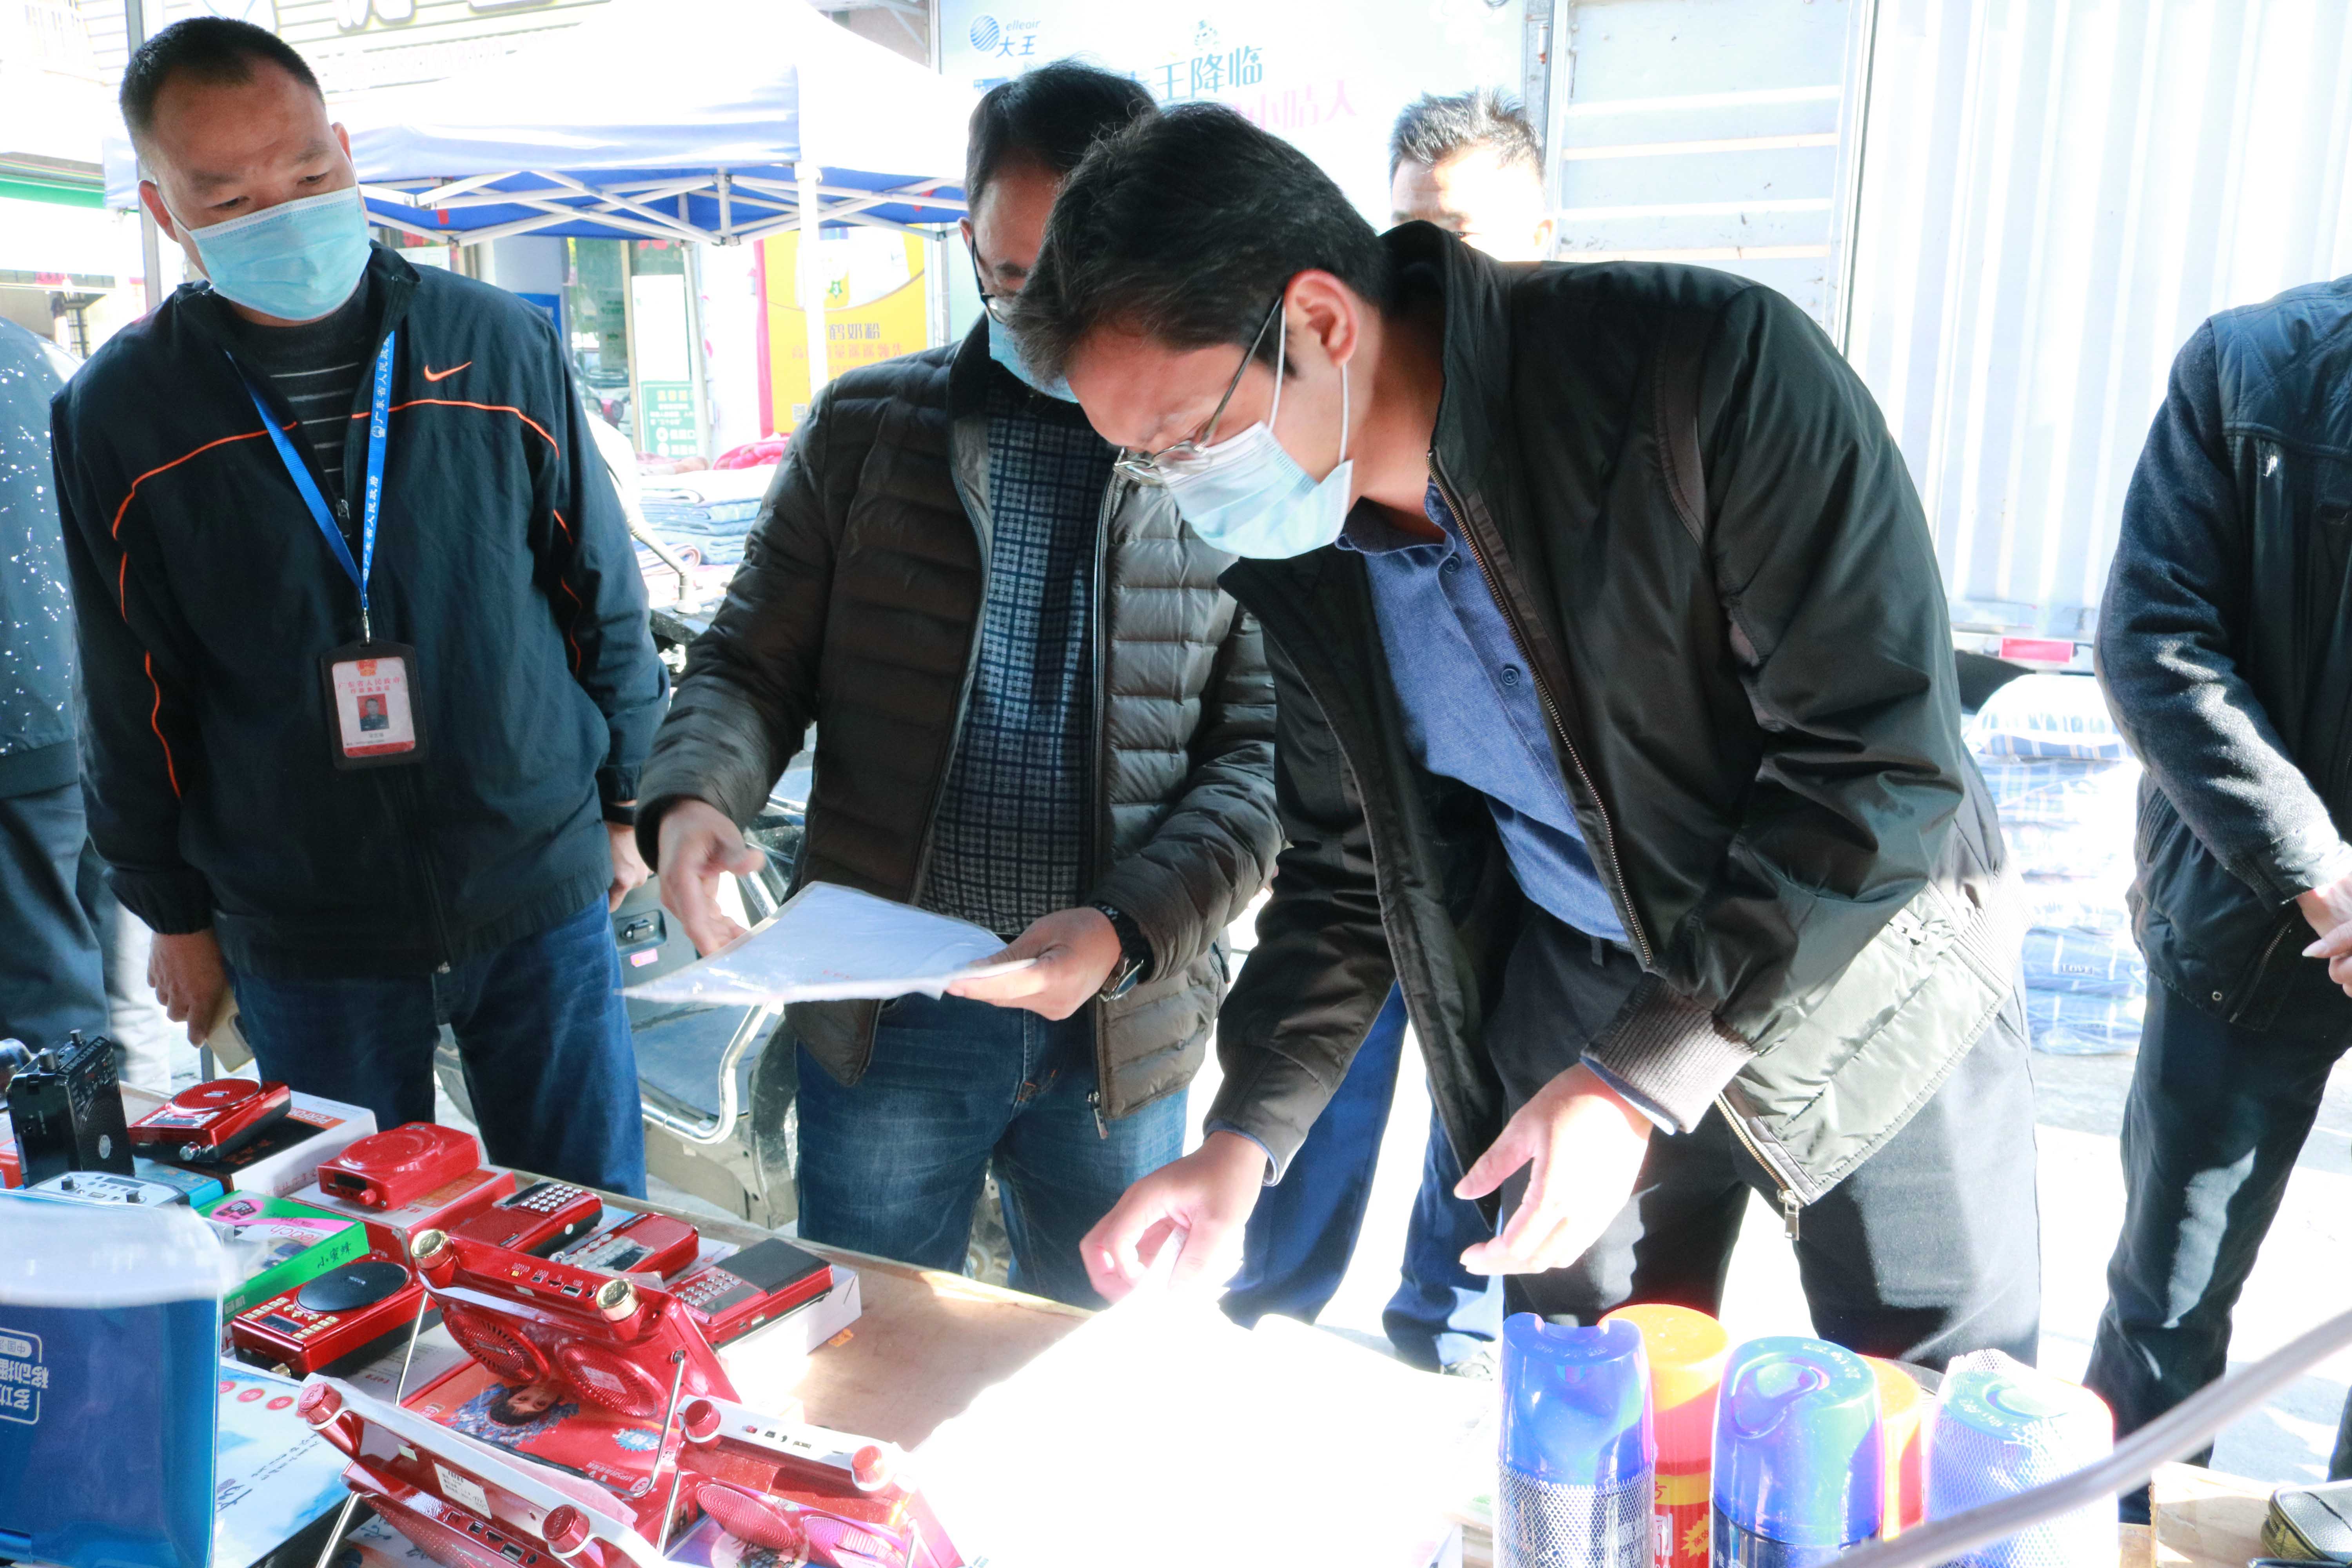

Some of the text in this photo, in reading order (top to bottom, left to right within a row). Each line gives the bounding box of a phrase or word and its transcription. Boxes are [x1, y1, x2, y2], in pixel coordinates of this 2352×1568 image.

[1005, 18, 1041, 32] elleair
[995, 34, 1037, 58] 大王
[1130, 45, 1263, 103] 王降临
[824, 323, 880, 340] 鹤奶粉
[374, 336, 391, 424] 广东省人民政府
[363, 474, 379, 568] 广东省人民政府
[317, 1241, 352, 1269] 小蜜蜂
